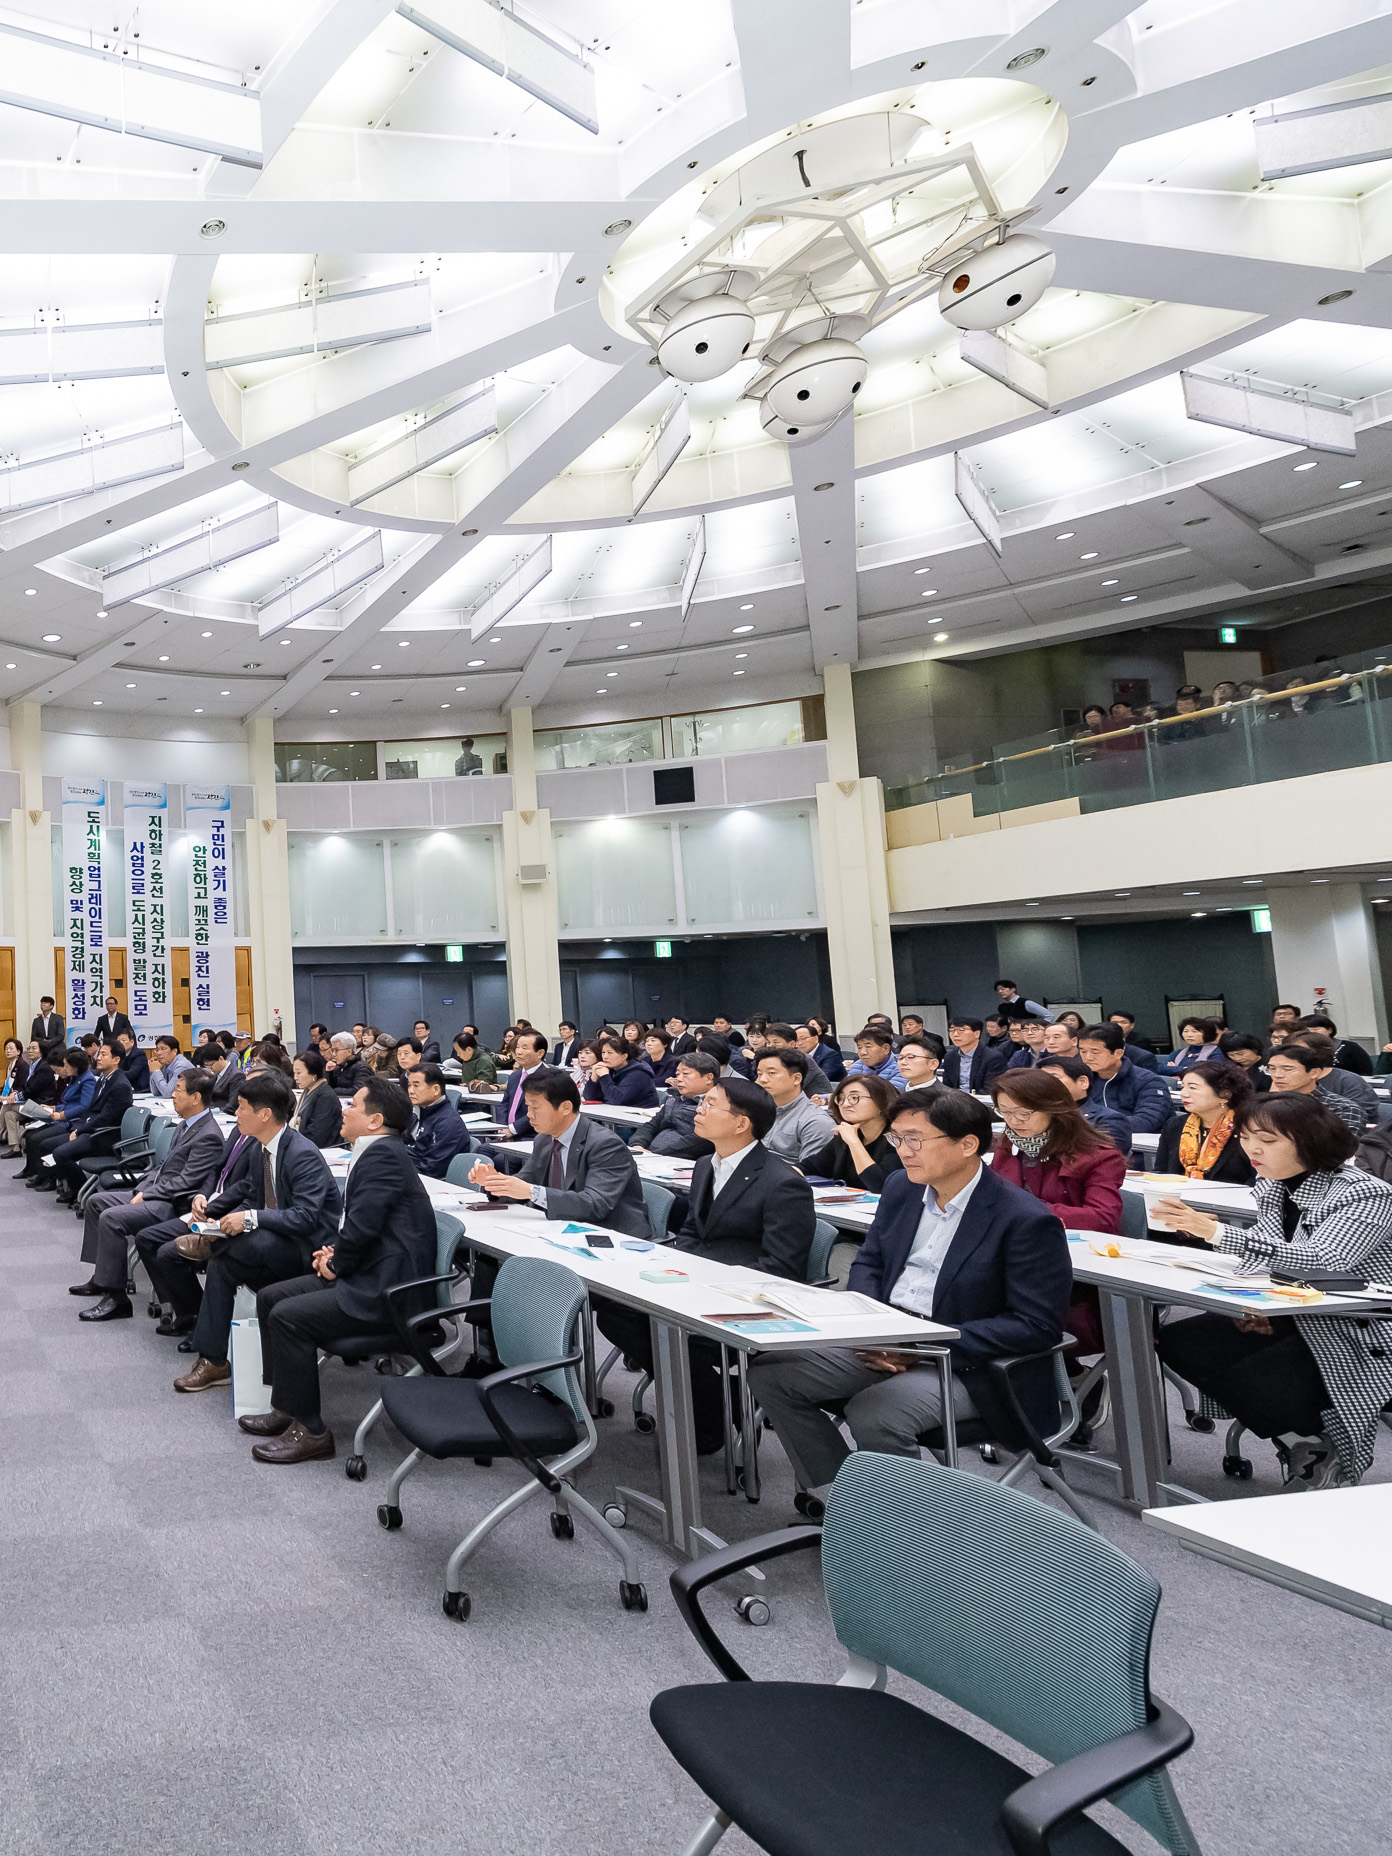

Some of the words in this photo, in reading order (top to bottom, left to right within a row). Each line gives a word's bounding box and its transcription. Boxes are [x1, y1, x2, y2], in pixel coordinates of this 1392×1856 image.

[148, 815, 164, 856] 지하철
[211, 819, 226, 861] 구민이
[69, 866, 85, 894] 향상
[129, 841, 145, 895] 사업으로
[150, 859, 164, 899] 2호선
[192, 845, 208, 900] 안전하고
[212, 864, 227, 892] 살기
[70, 899, 84, 913] 및
[193, 904, 210, 947] 깨끗한
[213, 897, 228, 924] 좋은
[70, 917, 85, 974] 지역경제
[131, 900, 147, 955] 도시균형
[150, 903, 167, 958] 지상구간
[89, 952, 105, 1008] 지역가치
[132, 958, 148, 986] 발전
[151, 963, 167, 1004] 지하화
[195, 950, 210, 978] 광진
[71, 978, 87, 1021] 활성화
[133, 989, 148, 1017] 도모
[195, 983, 211, 1012] 실현
